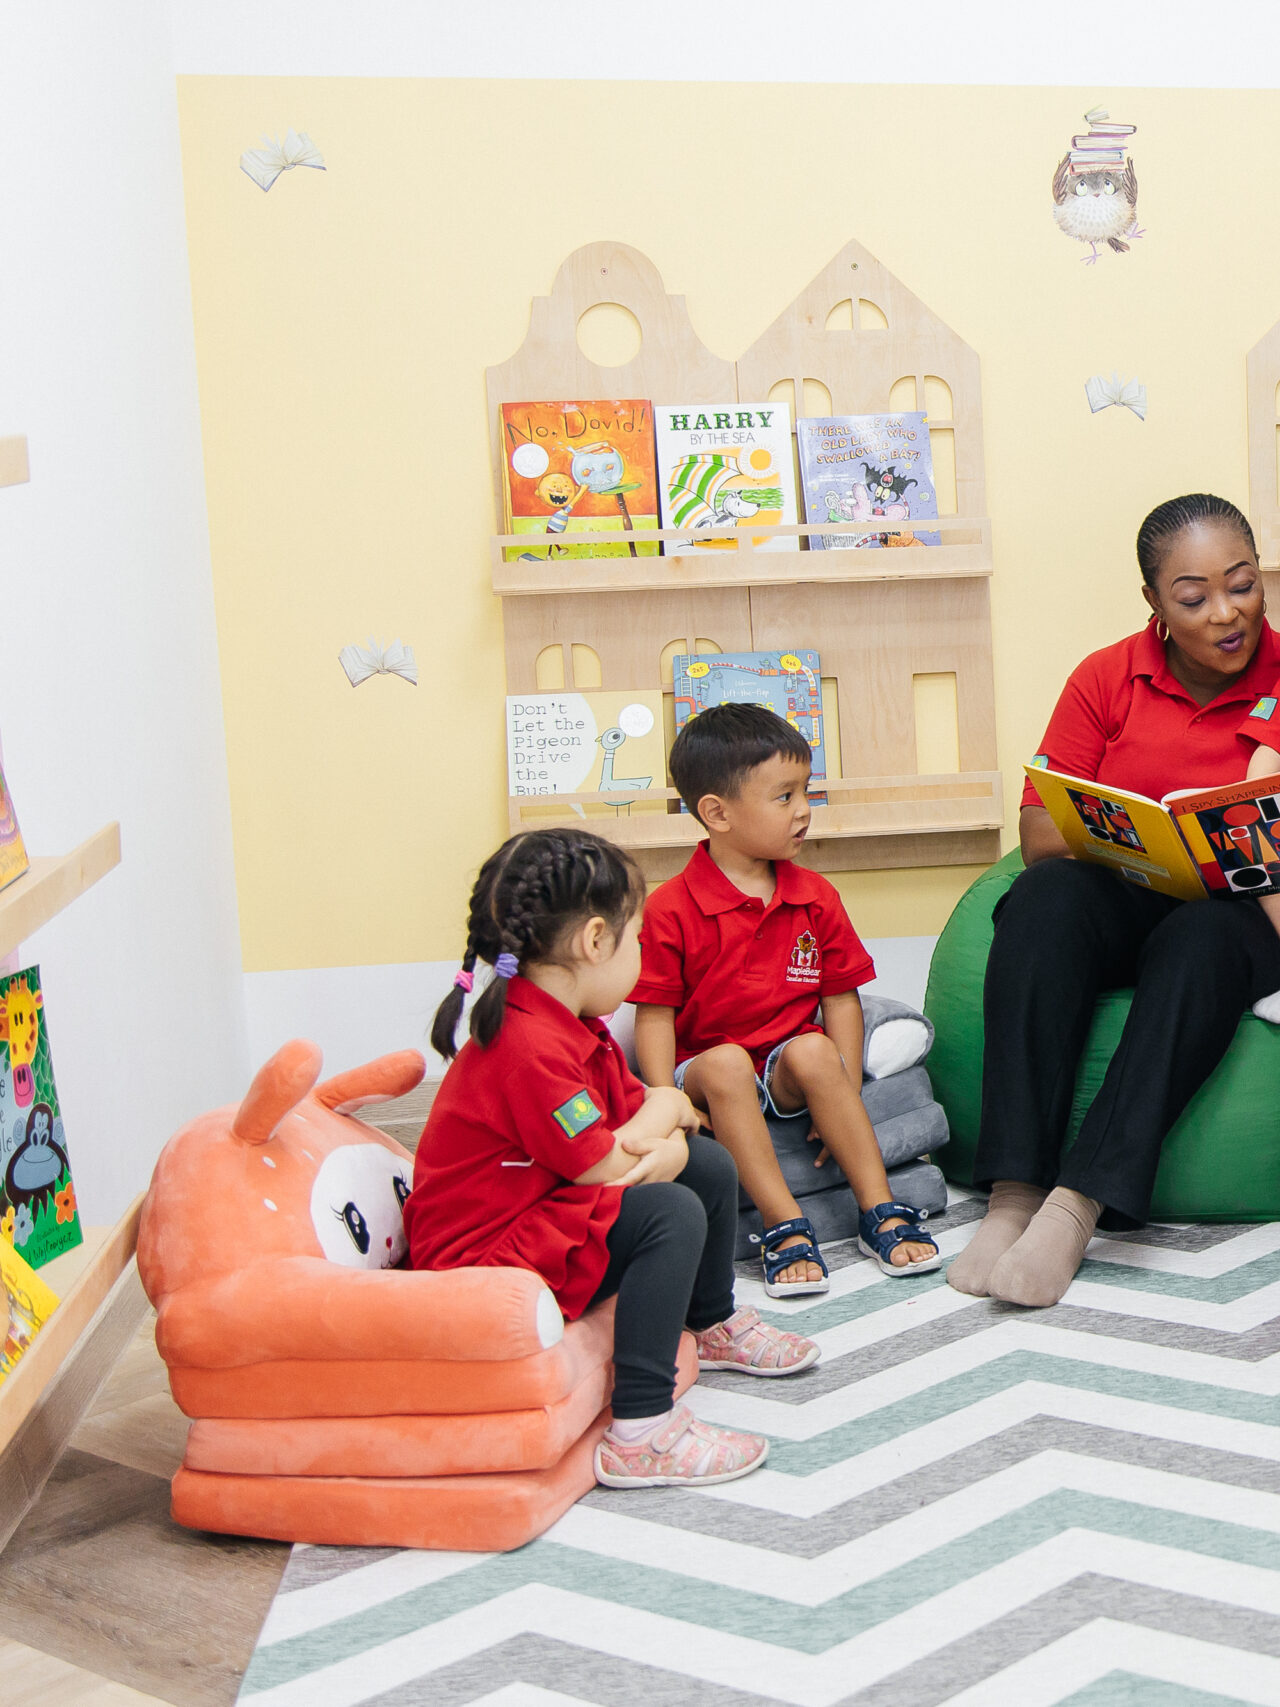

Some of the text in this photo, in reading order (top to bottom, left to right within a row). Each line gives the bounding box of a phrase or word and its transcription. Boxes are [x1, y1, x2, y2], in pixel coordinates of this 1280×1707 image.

[669, 411, 774, 431] HARRY
[809, 425, 851, 437] THERE
[885, 417, 904, 428] AN
[690, 432, 756, 446] BY THE SEA
[821, 438, 848, 451] OLD
[887, 428, 917, 441] WHO
[879, 454, 888, 463] A
[512, 702, 568, 716] Don't
[513, 717, 585, 732] Let the
[514, 735, 582, 750] Pigeon
[514, 751, 571, 765] Drive
[516, 768, 549, 780] the
[515, 784, 557, 797] Bus!
